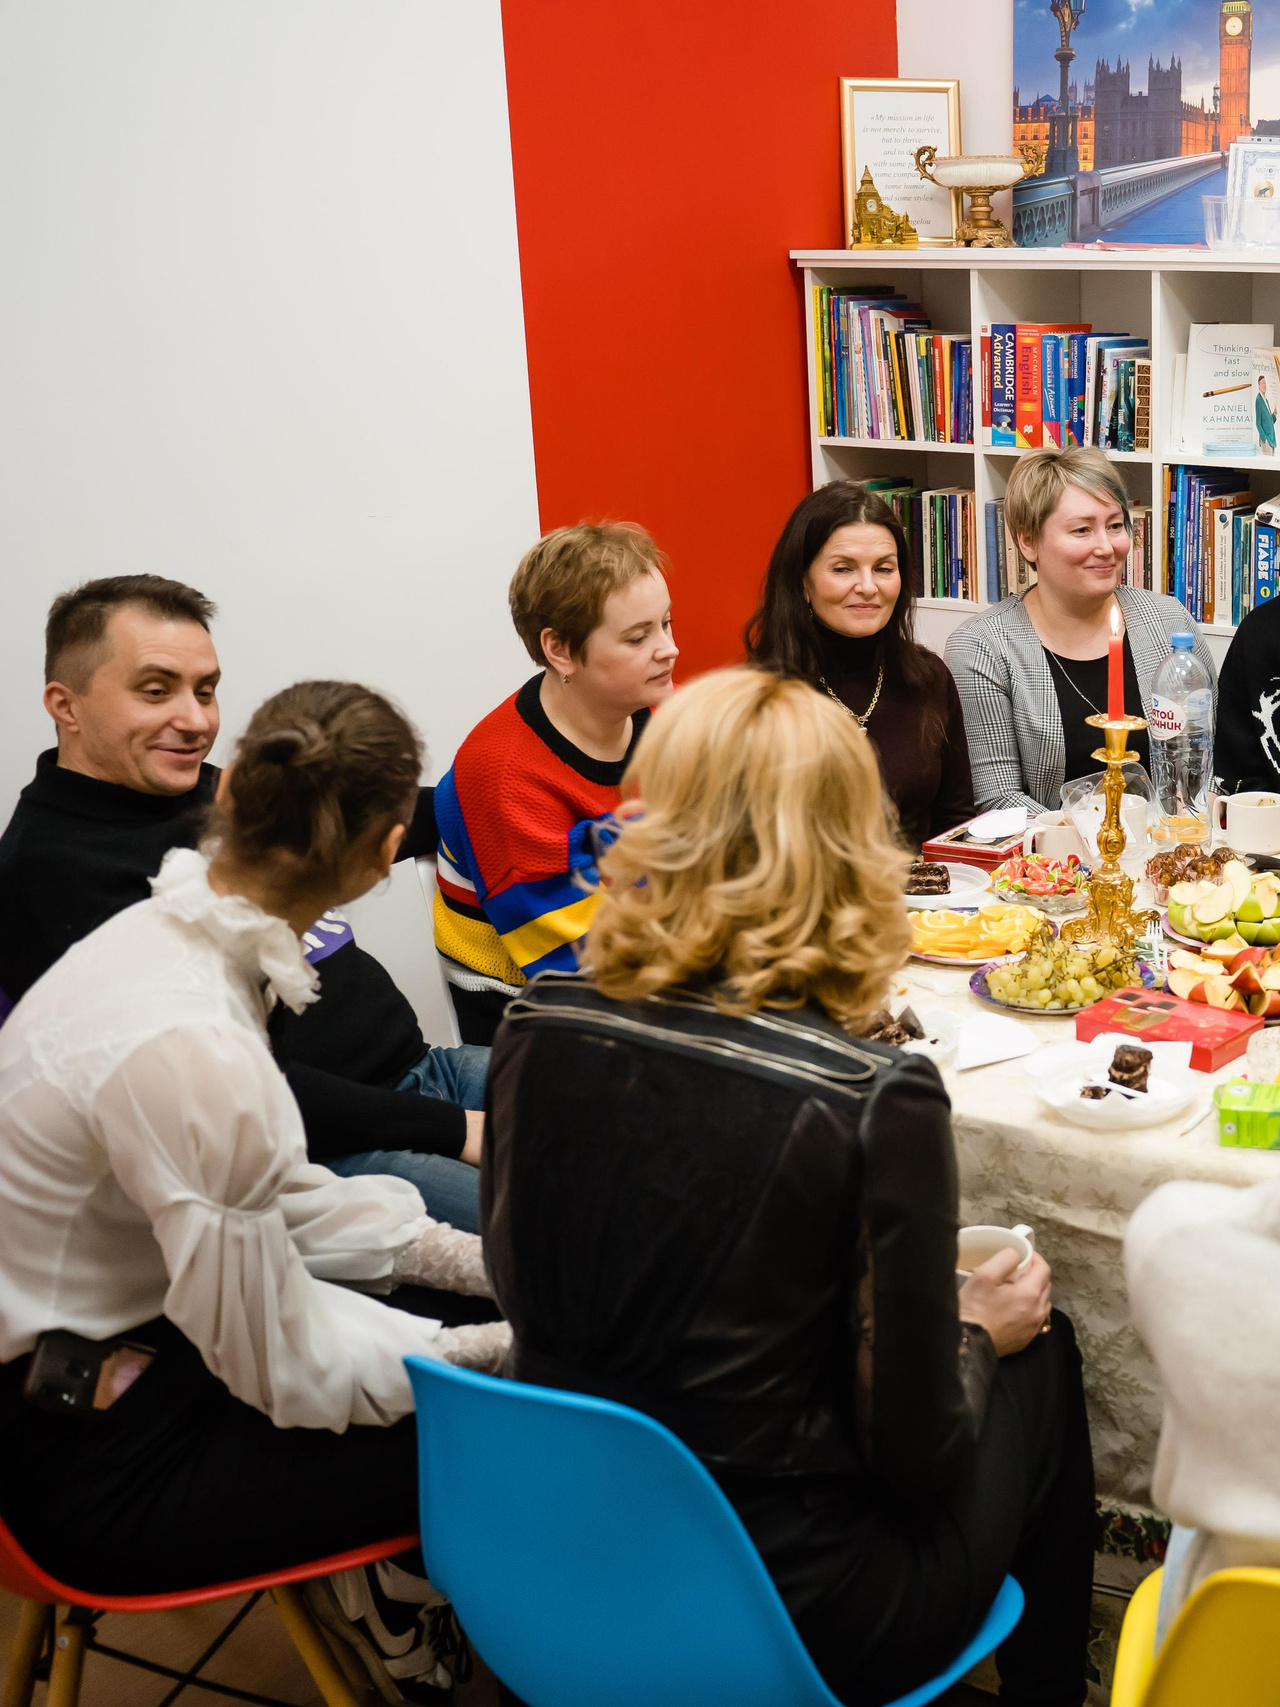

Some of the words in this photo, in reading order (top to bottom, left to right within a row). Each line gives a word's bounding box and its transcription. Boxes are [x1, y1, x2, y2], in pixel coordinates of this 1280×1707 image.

[923, 114, 935, 122] life
[883, 127, 906, 135] merely
[1213, 344, 1252, 355] Thinking,
[993, 332, 1004, 389] Advanced
[1046, 344, 1056, 388] Essential
[1224, 356, 1241, 366] fast
[1004, 332, 1015, 401] CAMBRIDGE
[1018, 346, 1033, 397] English
[1213, 369, 1229, 378] and
[1231, 369, 1250, 378] slow
[1213, 404, 1248, 413] DANIEL
[1257, 534, 1270, 581] FIABE
